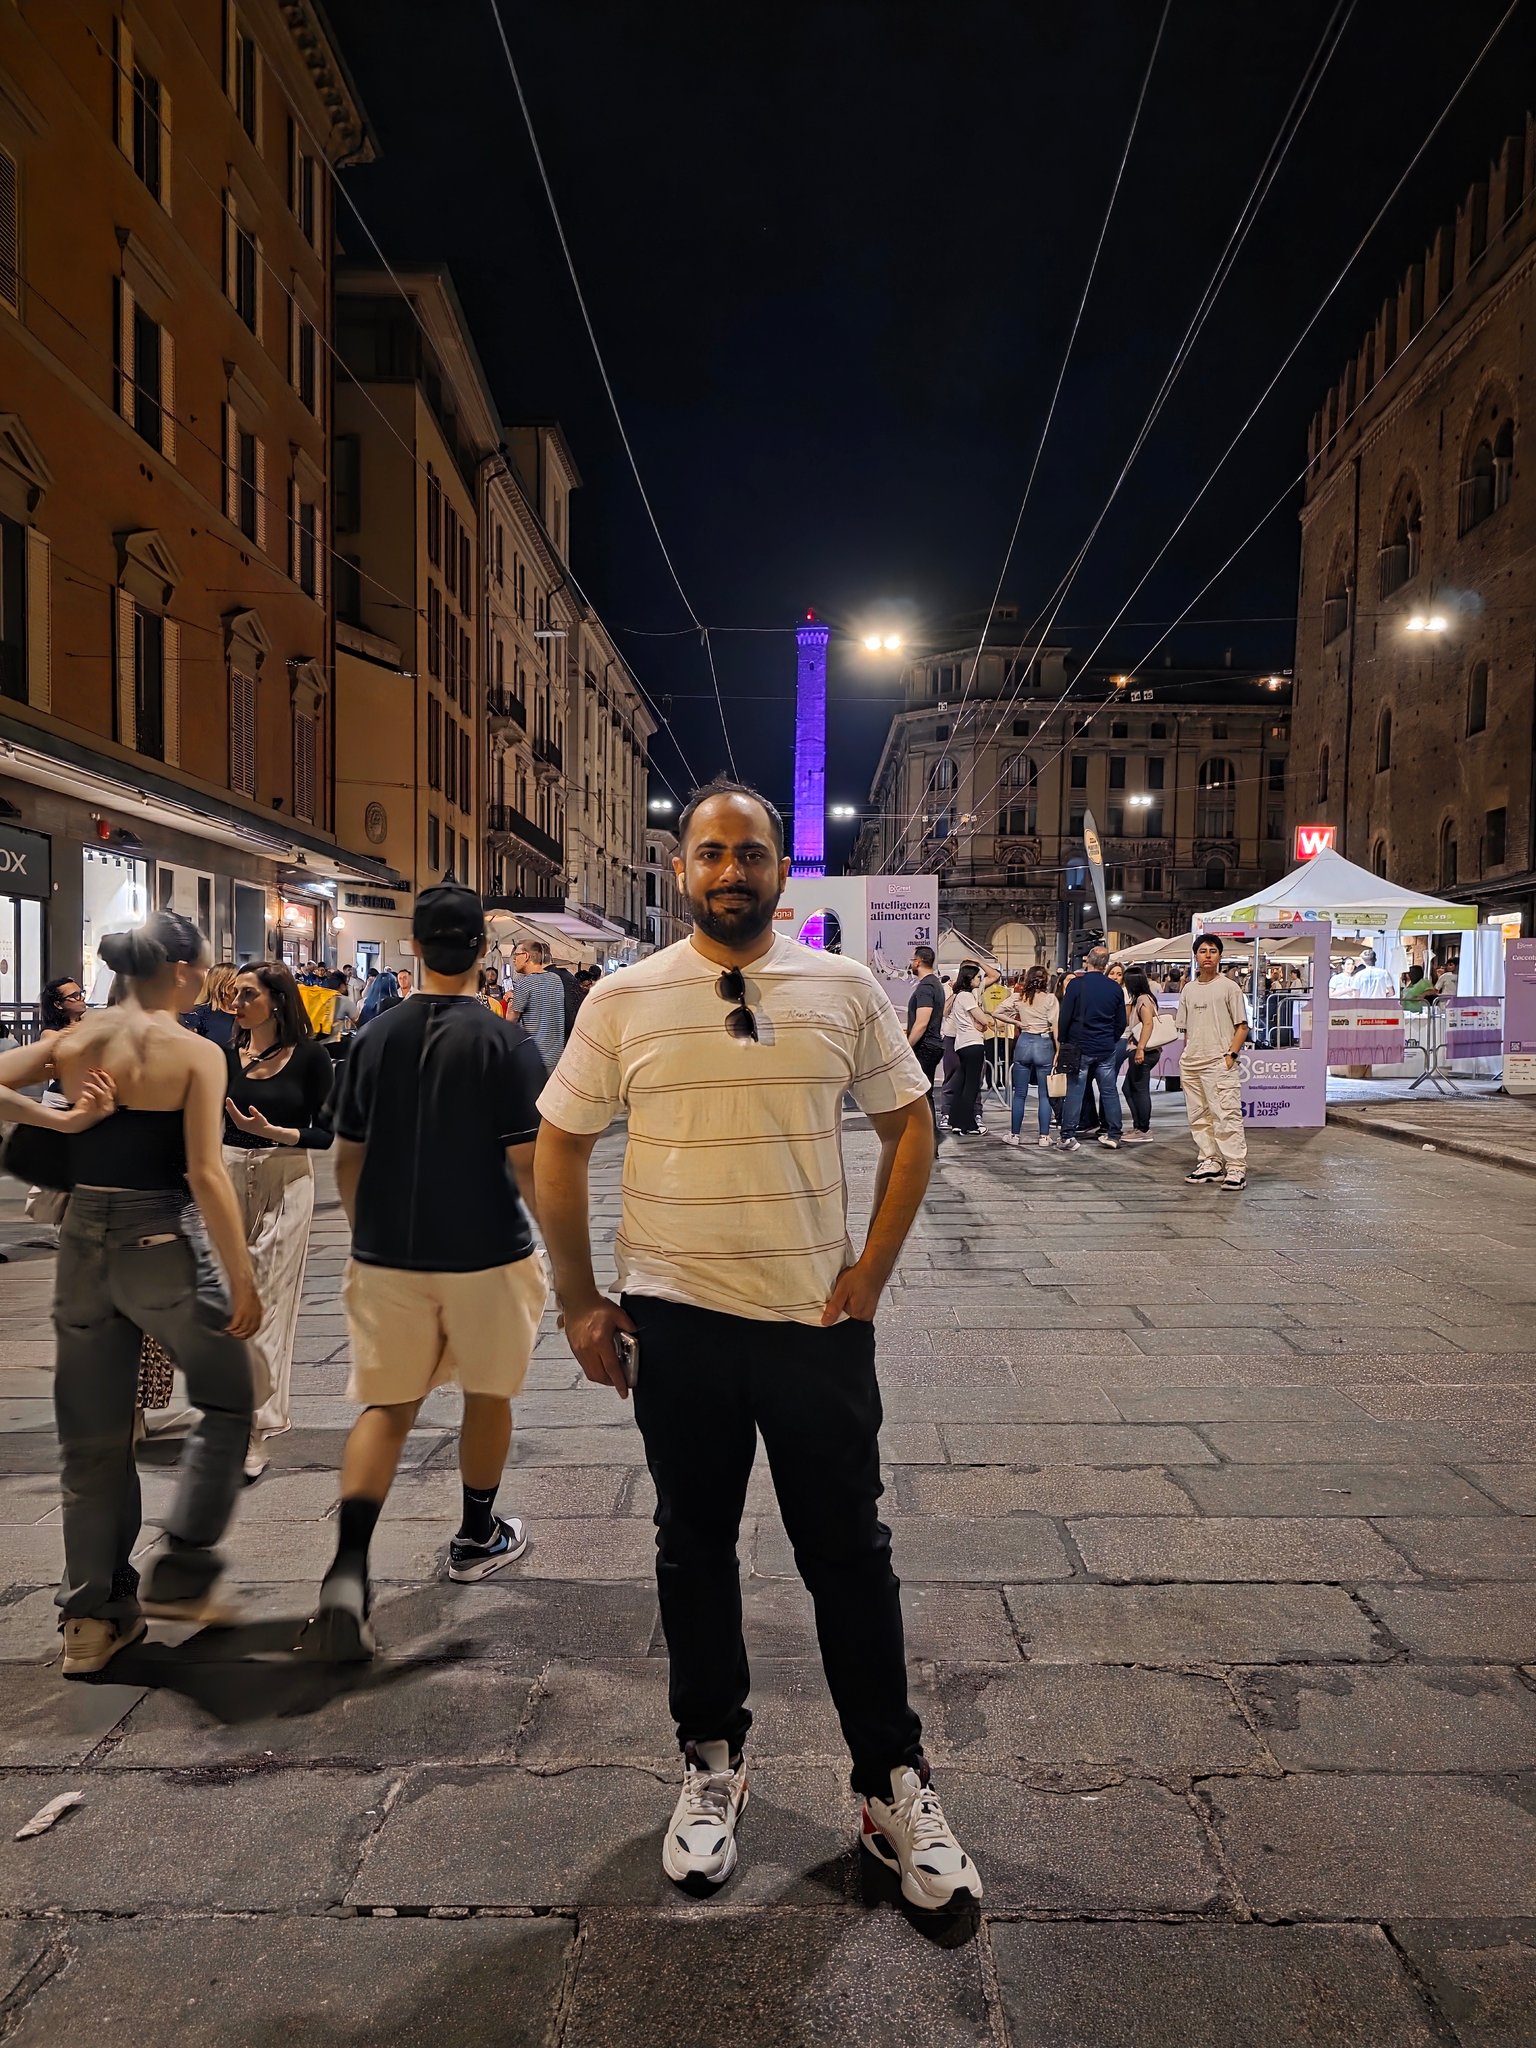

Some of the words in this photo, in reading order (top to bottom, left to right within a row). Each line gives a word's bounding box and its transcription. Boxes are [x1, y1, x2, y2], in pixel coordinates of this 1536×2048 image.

[1300, 832, 1330, 854] W
[870, 900, 930, 911] Intelligenza
[870, 911, 931, 920] alimentare
[914, 926, 930, 940] 31
[1251, 1059, 1297, 1075] Great
[1257, 1100, 1291, 1110] Maggio
[1257, 1109, 1279, 1117] 2025
